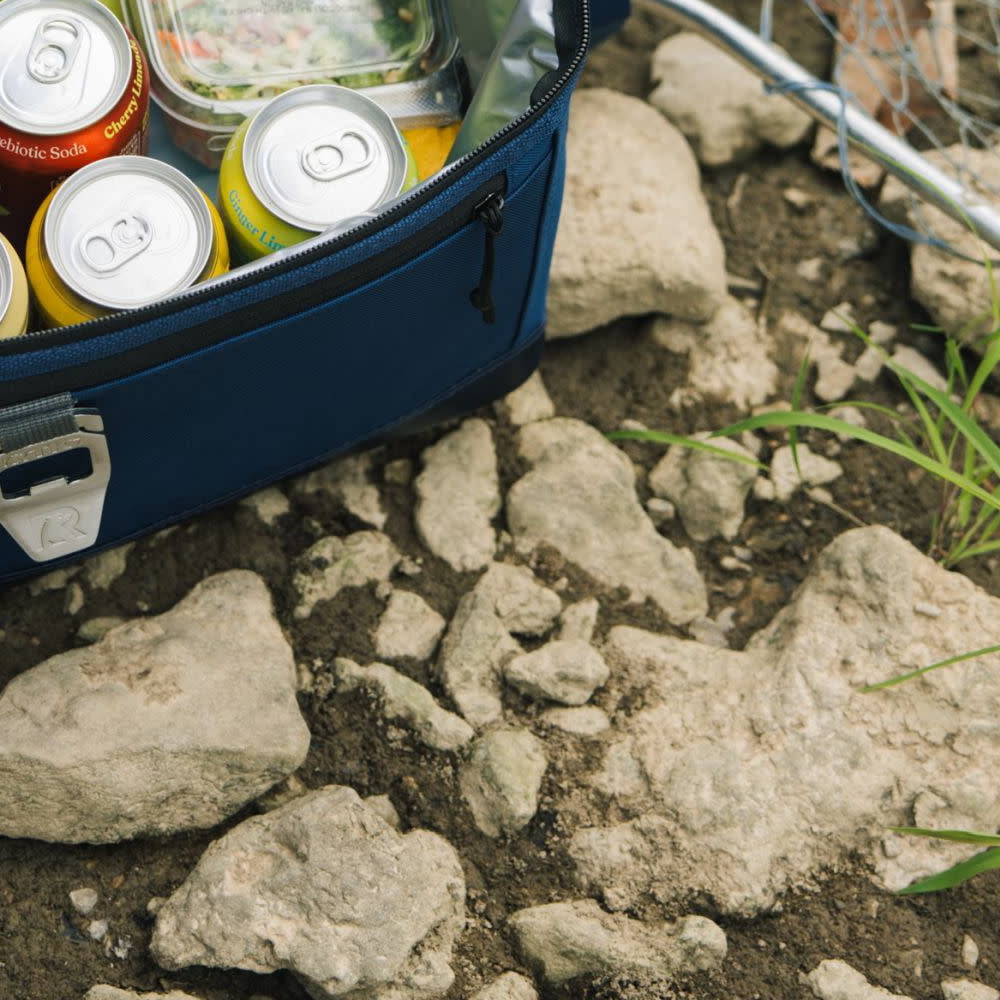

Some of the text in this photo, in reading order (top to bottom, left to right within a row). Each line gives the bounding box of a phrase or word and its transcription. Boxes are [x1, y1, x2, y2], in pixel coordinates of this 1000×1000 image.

[104, 96, 138, 139] Cherry
[50, 143, 88, 160] Soda
[230, 189, 259, 235] Ginger
